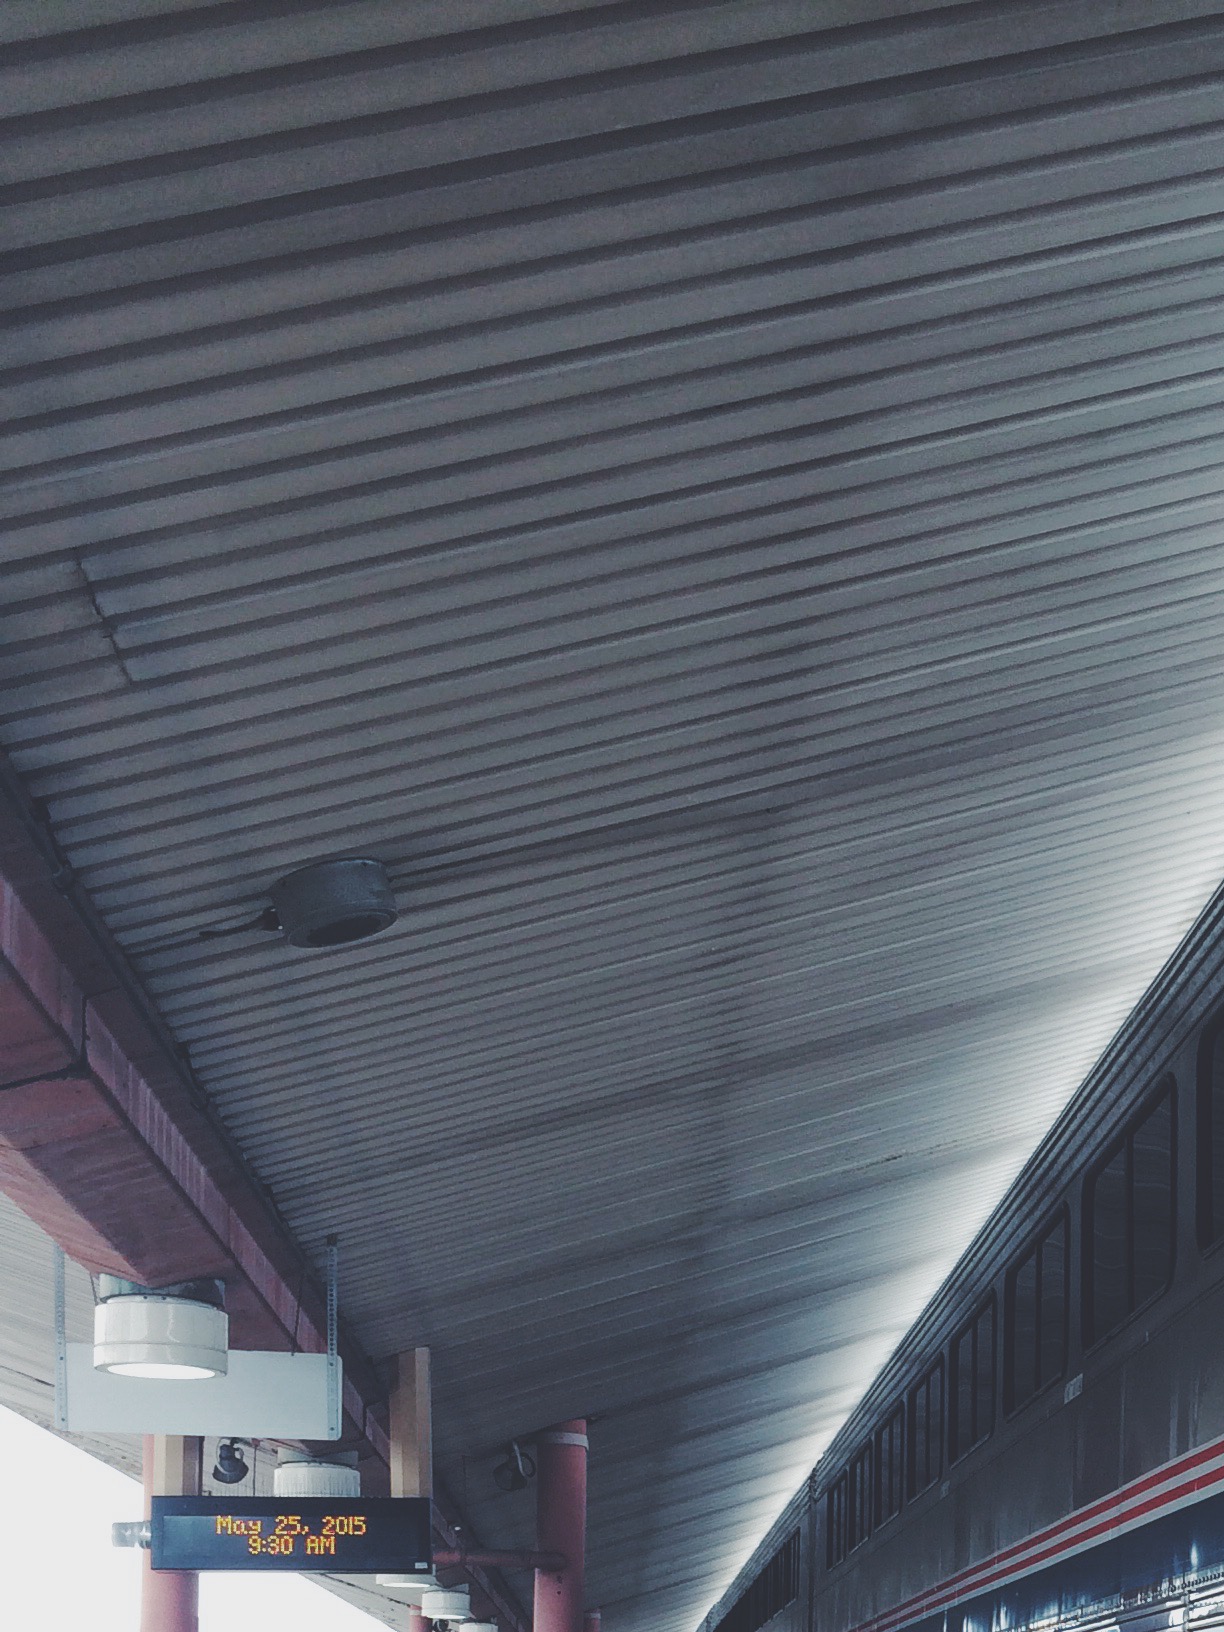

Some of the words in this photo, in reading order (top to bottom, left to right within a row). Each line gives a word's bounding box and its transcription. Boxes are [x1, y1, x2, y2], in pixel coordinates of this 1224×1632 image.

[215, 1515, 262, 1535] May
[275, 1515, 310, 1536] 25,
[321, 1516, 367, 1535] 2015
[248, 1535, 294, 1555] 9:30
[306, 1535, 336, 1555] AM
